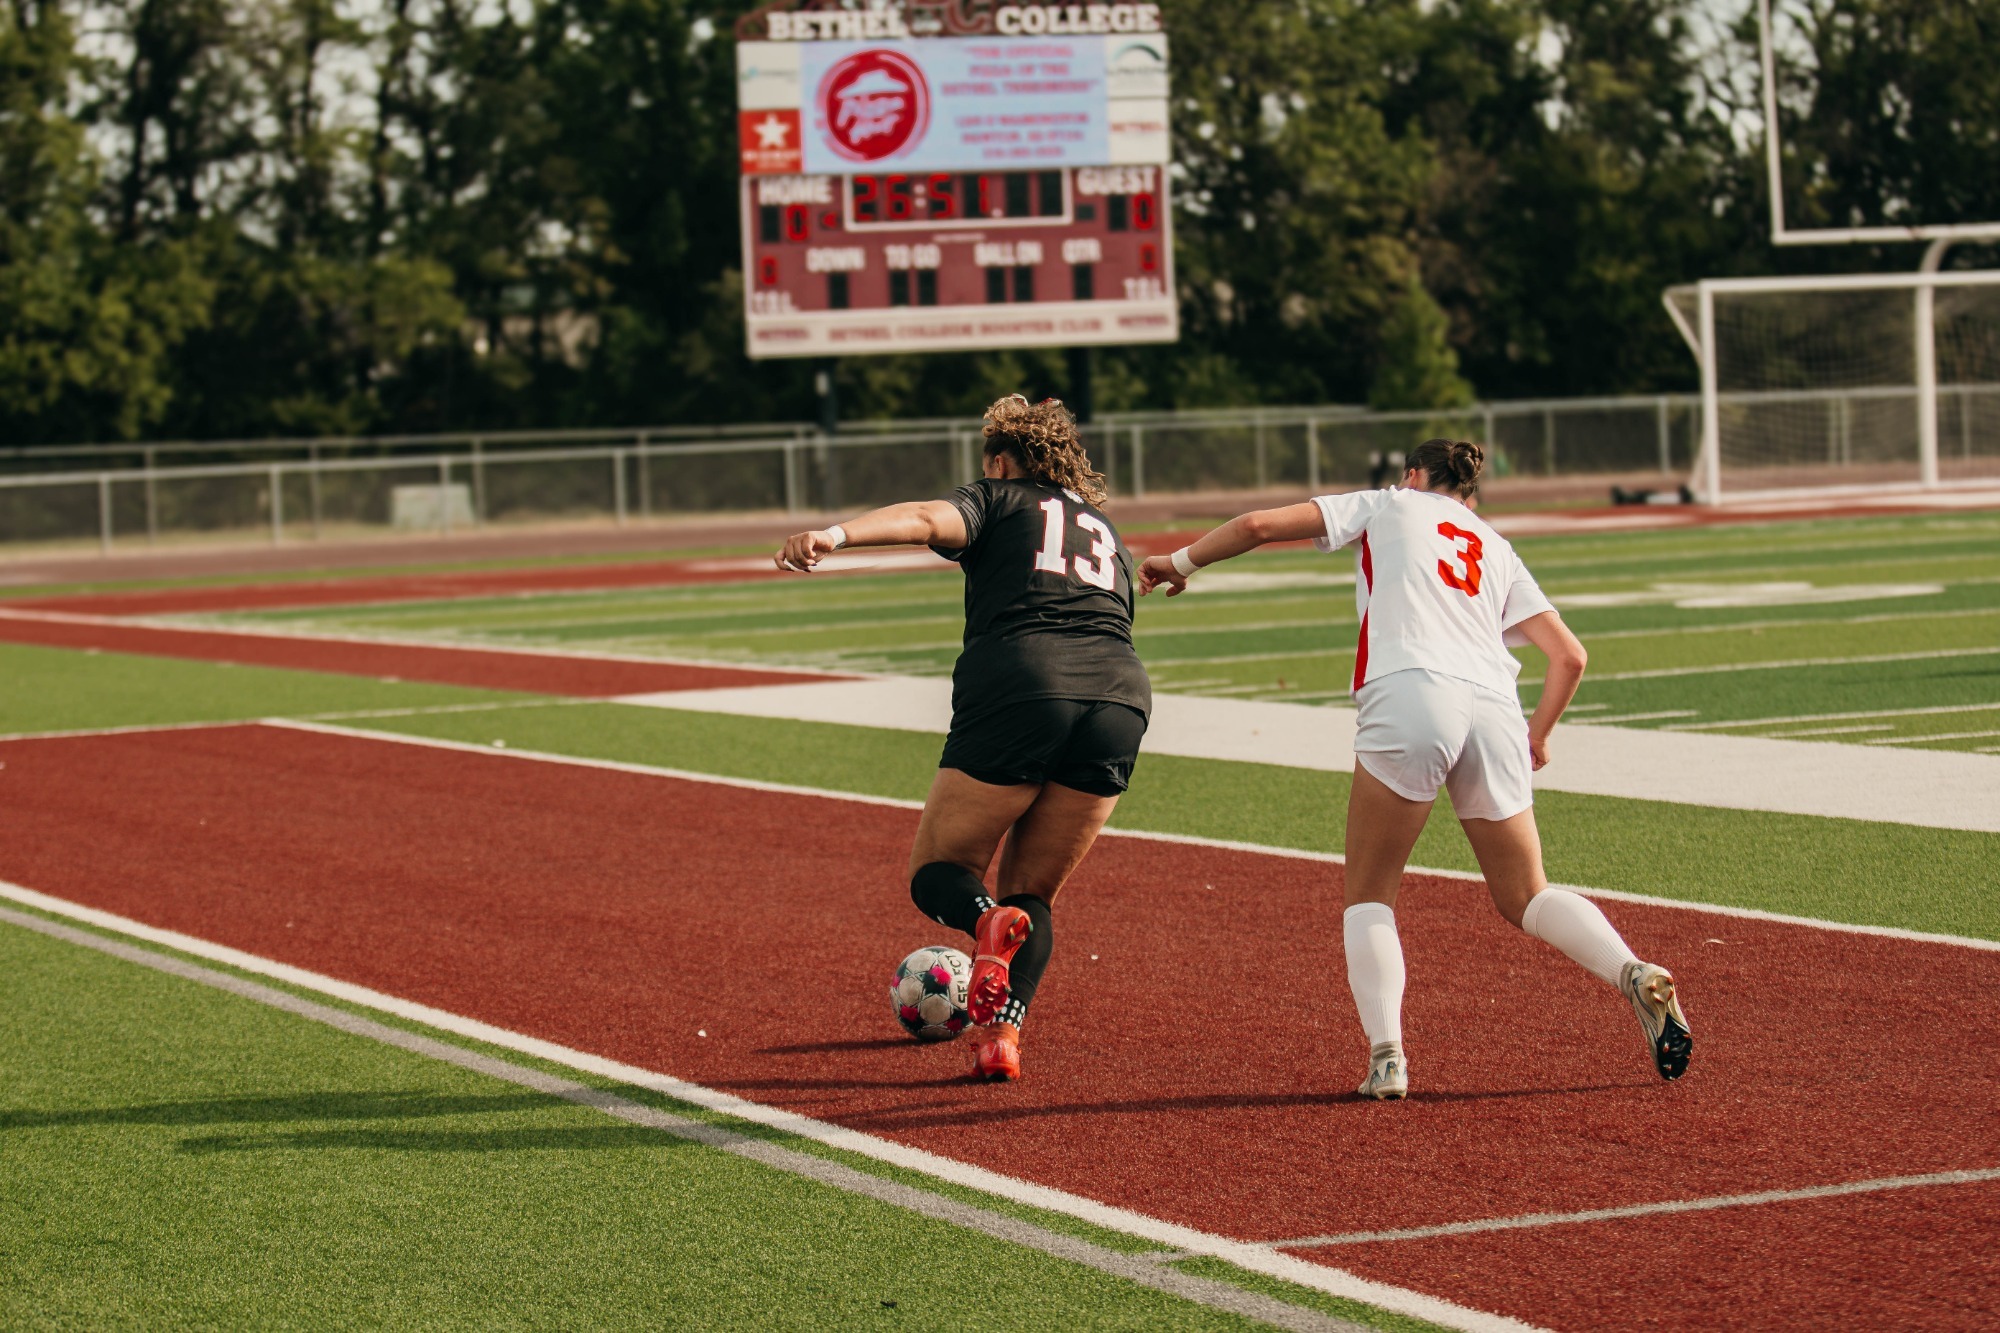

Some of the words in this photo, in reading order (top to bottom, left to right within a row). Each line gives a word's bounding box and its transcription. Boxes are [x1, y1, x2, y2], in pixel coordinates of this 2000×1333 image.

[767, 11, 909, 40] BETHEL
[995, 4, 1162, 34] COLLEGE
[759, 174, 833, 205] HOME
[1077, 165, 1156, 196] GUEST
[785, 203, 809, 242] 0
[1132, 191, 1155, 231] 0
[806, 246, 866, 273] DOWN
[884, 244, 911, 270] TO
[912, 243, 942, 270] GO
[974, 241, 1016, 267] BALL
[1016, 239, 1044, 266] ON
[1061, 237, 1102, 264] QTR
[1033, 497, 1118, 592] 13
[1437, 521, 1483, 598] 3
